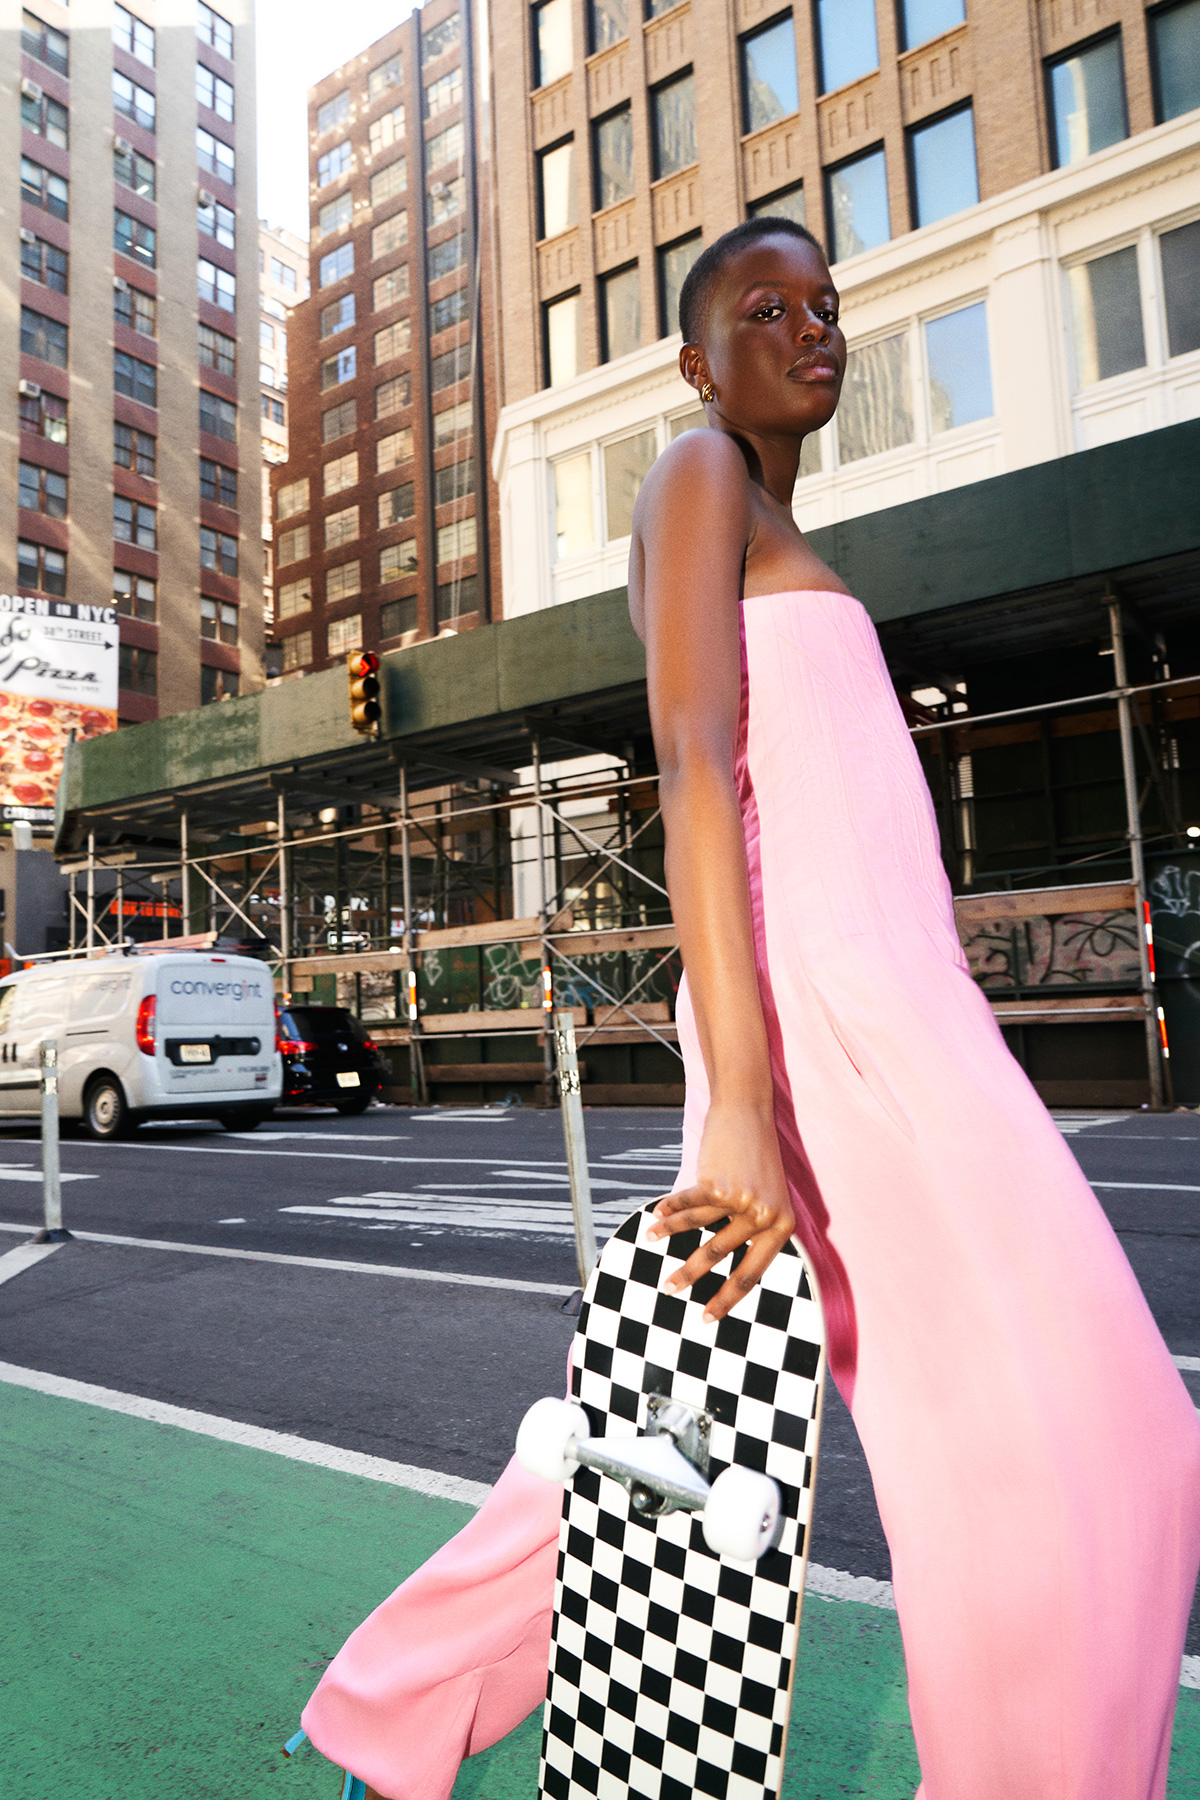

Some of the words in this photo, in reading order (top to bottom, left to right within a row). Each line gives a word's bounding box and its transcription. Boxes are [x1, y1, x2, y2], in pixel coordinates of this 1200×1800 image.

[0, 594, 50, 616] OPEN
[56, 603, 71, 616] IN
[77, 604, 117, 624] NYC
[67, 628, 102, 641] STREET
[3, 656, 98, 683] Pizza
[3, 806, 56, 821] CATERING
[170, 980, 262, 1001] convergint
